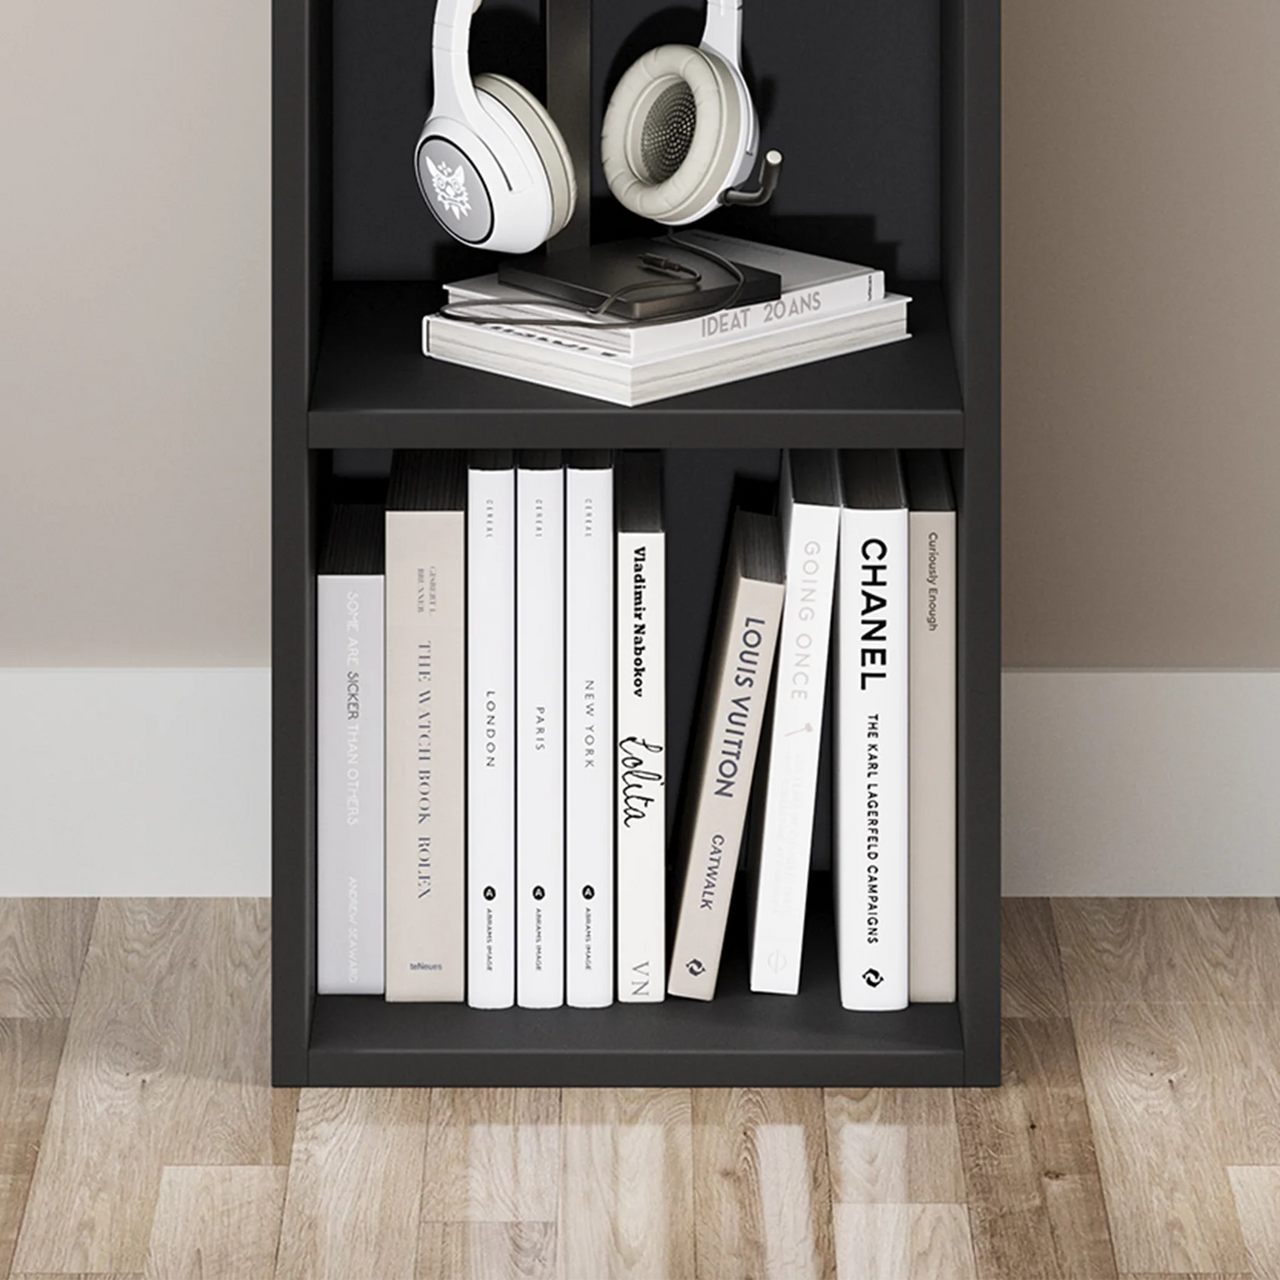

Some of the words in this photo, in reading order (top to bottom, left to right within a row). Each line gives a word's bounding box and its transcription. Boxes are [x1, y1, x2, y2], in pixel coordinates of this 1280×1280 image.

[701, 308, 751, 337] IDEAT
[763, 301, 786, 323] 20
[788, 291, 821, 316] ANS
[486, 498, 494, 538] CEREAL
[535, 498, 543, 538] CEREAL
[585, 497, 593, 538] CEREAL
[798, 540, 821, 622] GOING
[926, 531, 939, 586] Curiously
[633, 545, 647, 621] Vladimir
[346, 591, 360, 632] SOME
[860, 537, 888, 691] CHANEL
[926, 587, 938, 632] Enough
[346, 636, 360, 666] ARE
[417, 640, 432, 683] THE
[633, 623, 647, 698] Nabokov
[735, 618, 765, 688] LOUIS
[790, 633, 813, 700] ONCE
[346, 670, 360, 721] SICKER
[584, 679, 596, 717] NEW
[347, 723, 360, 764] THAN
[417, 689, 432, 762] WATCH
[485, 690, 497, 768] LONDON
[534, 706, 546, 751] PARIS
[584, 724, 596, 769] YORK
[715, 696, 751, 797] VUITTON
[866, 713, 879, 739] THE
[619, 735, 665, 829] Lolita
[866, 743, 879, 779] KARL
[346, 768, 360, 826] OTHERS
[417, 768, 432, 825] BOOK
[866, 783, 879, 861] LAGERFELD
[417, 836, 432, 899] ROLEX
[700, 834, 725, 910] CATWALK
[486, 907, 494, 944] ABRAMS
[535, 907, 543, 944] ABRAMS
[585, 906, 593, 943] ABRAMS
[866, 864, 879, 945] CAMPAIGNS
[631, 960, 650, 996] VN
